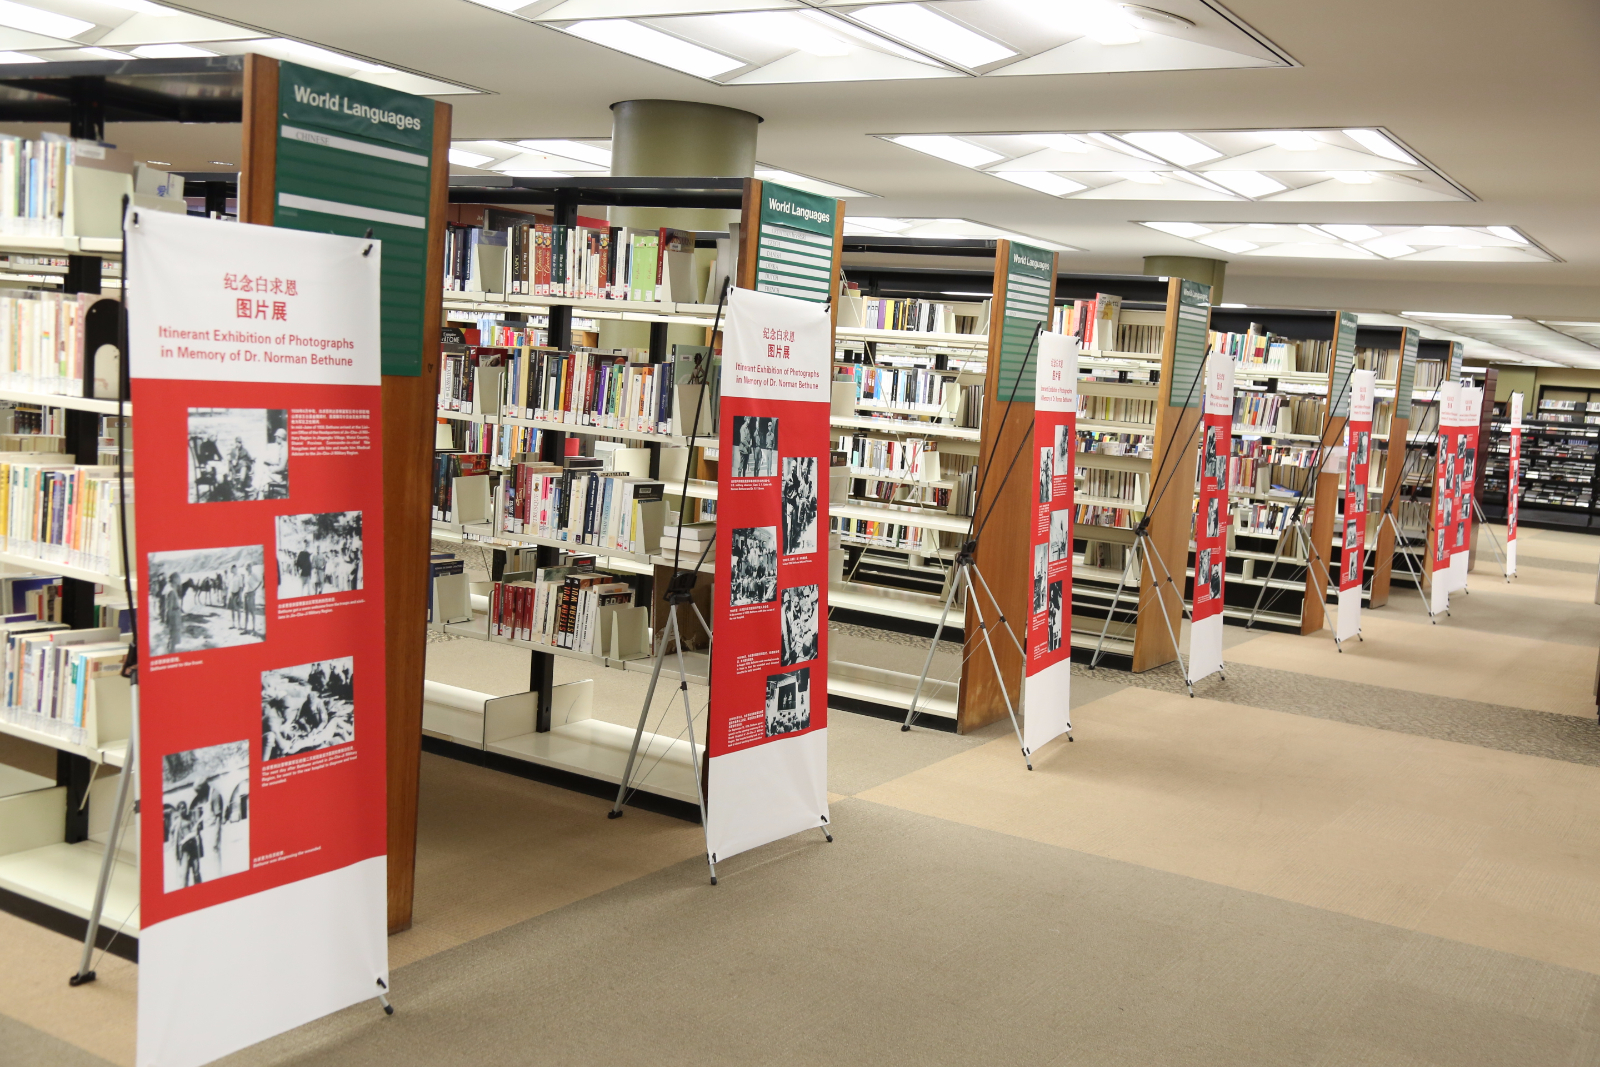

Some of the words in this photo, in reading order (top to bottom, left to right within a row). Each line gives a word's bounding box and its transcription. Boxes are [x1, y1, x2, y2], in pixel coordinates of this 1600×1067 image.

[294, 84, 339, 112] World
[344, 97, 421, 130] Languages
[296, 131, 330, 146] CHINESE
[769, 198, 790, 214] World
[792, 204, 830, 222] Languages
[1014, 253, 1026, 265] World
[1027, 256, 1050, 270] Languages
[223, 272, 298, 296] 纪念白求恩
[236, 298, 288, 322] 图片展
[158, 325, 210, 341] Itinerant
[214, 329, 272, 346] Exhibition
[275, 334, 287, 346] of
[289, 334, 354, 351] Photographs
[763, 327, 795, 342] 纪念白求恩
[160, 346, 174, 358] in
[177, 346, 226, 364] Memory
[230, 350, 241, 362] of
[244, 350, 261, 363] Dr.
[264, 351, 308, 365] Norman
[311, 354, 353, 366] Bethune
[768, 344, 790, 360] 图片展
[736, 362, 756, 373] Itinerant
[757, 364, 782, 375] Exhibition
[784, 367, 789, 375] of
[790, 367, 820, 379] Photographs
[736, 375, 742, 384] in
[743, 375, 762, 387] Memory
[763, 377, 769, 387] of
[770, 378, 778, 387] Dr.
[778, 379, 797, 388] Norman
[798, 380, 819, 390] Bethune
